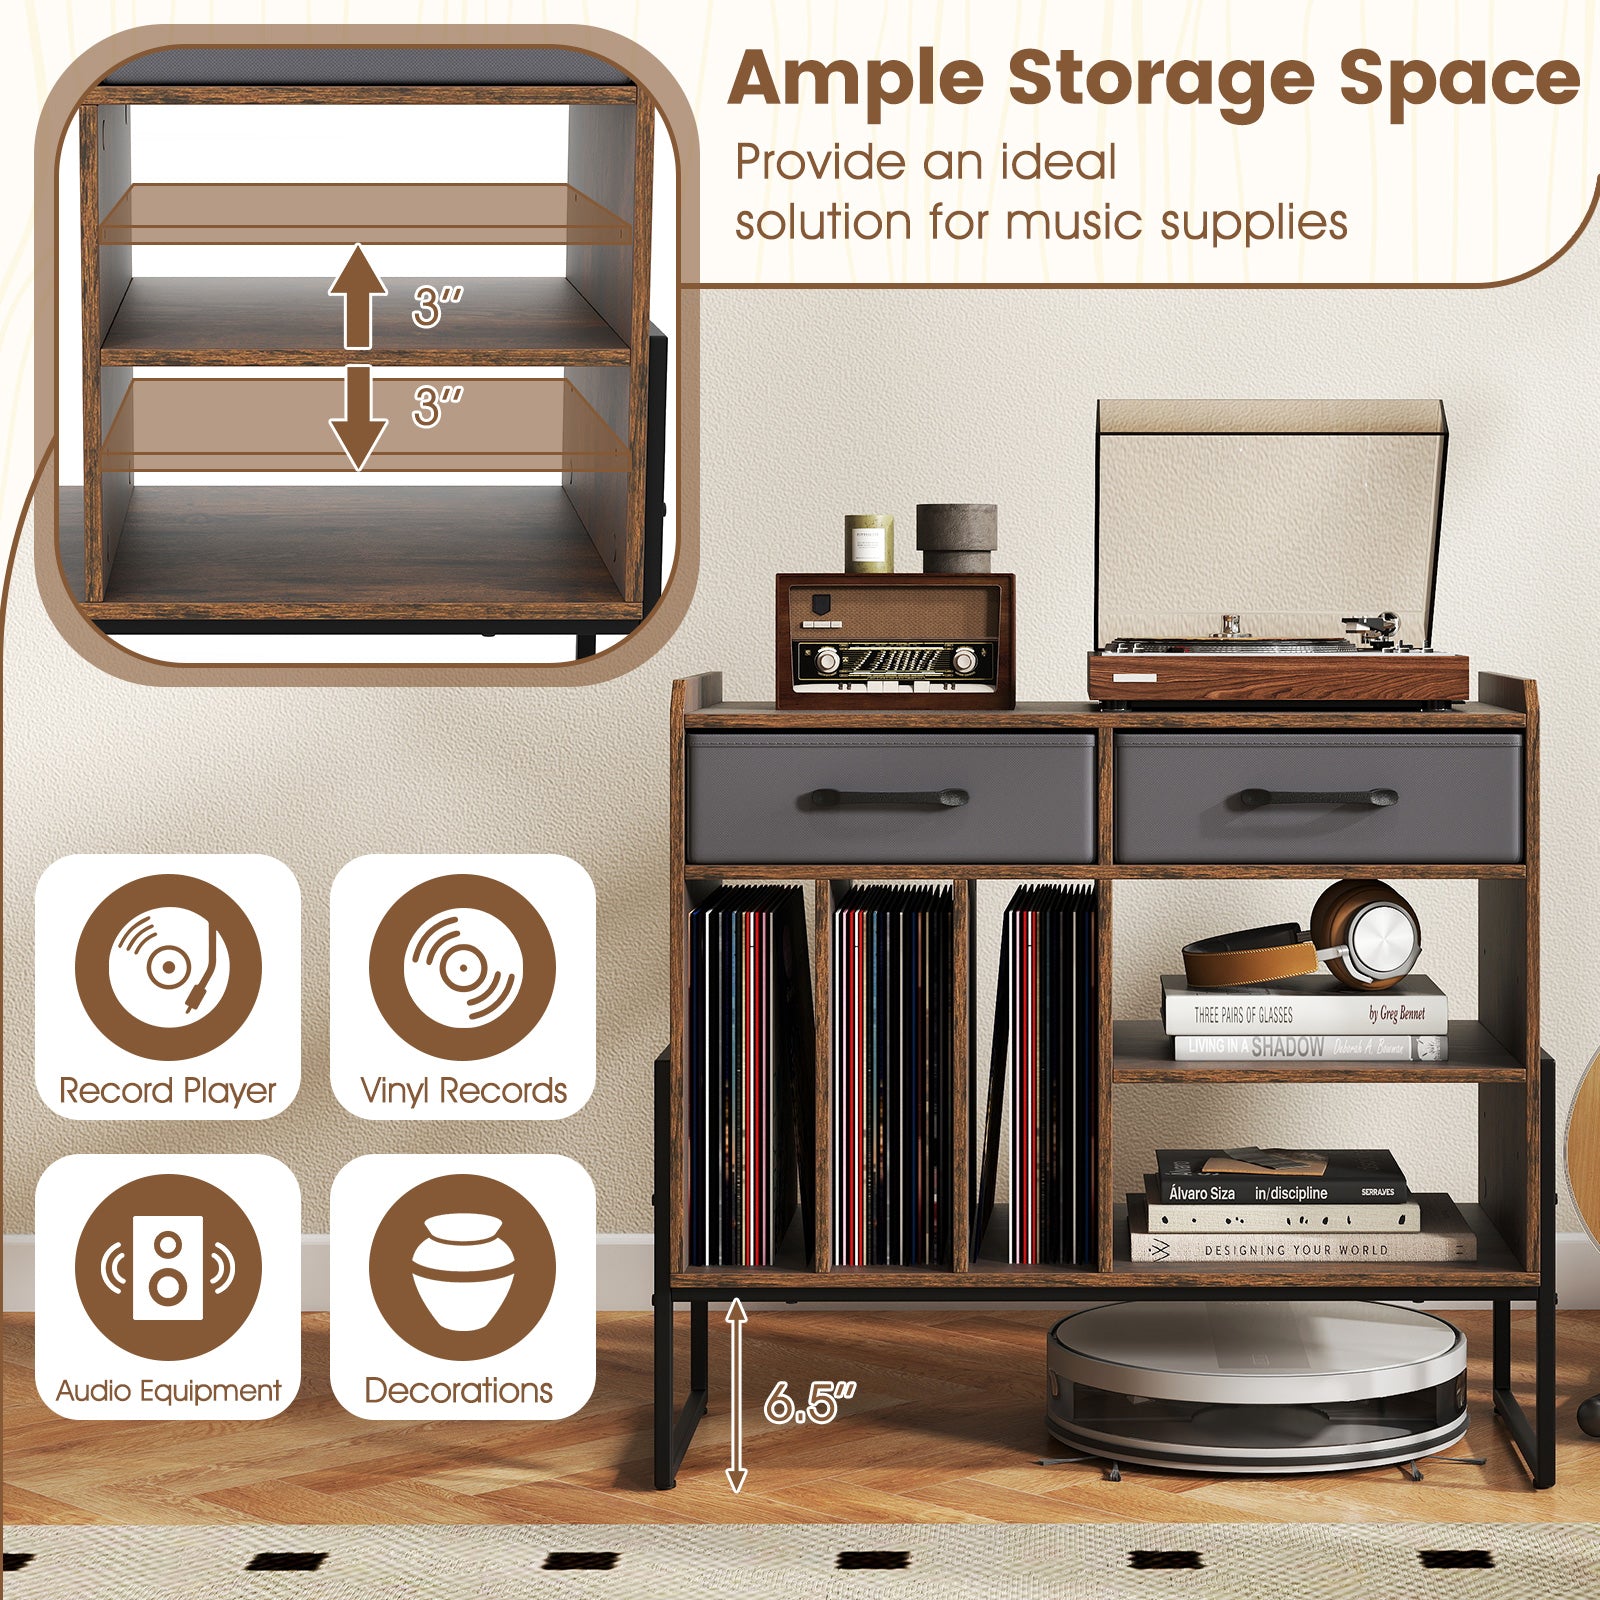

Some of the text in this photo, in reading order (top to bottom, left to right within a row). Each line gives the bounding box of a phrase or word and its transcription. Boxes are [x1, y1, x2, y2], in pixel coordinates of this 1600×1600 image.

[1194, 1006, 1293, 1023] THREE PAIRS OF GLASSES
[1369, 1004, 1426, 1024] by Greg Bennet
[1189, 1036, 1325, 1057] LIVING IN A SHADOW
[1169, 1183, 1328, 1202] Álvaro Siza in/discipline
[1205, 1245, 1389, 1256] DESIGNING YOUR WORLD
